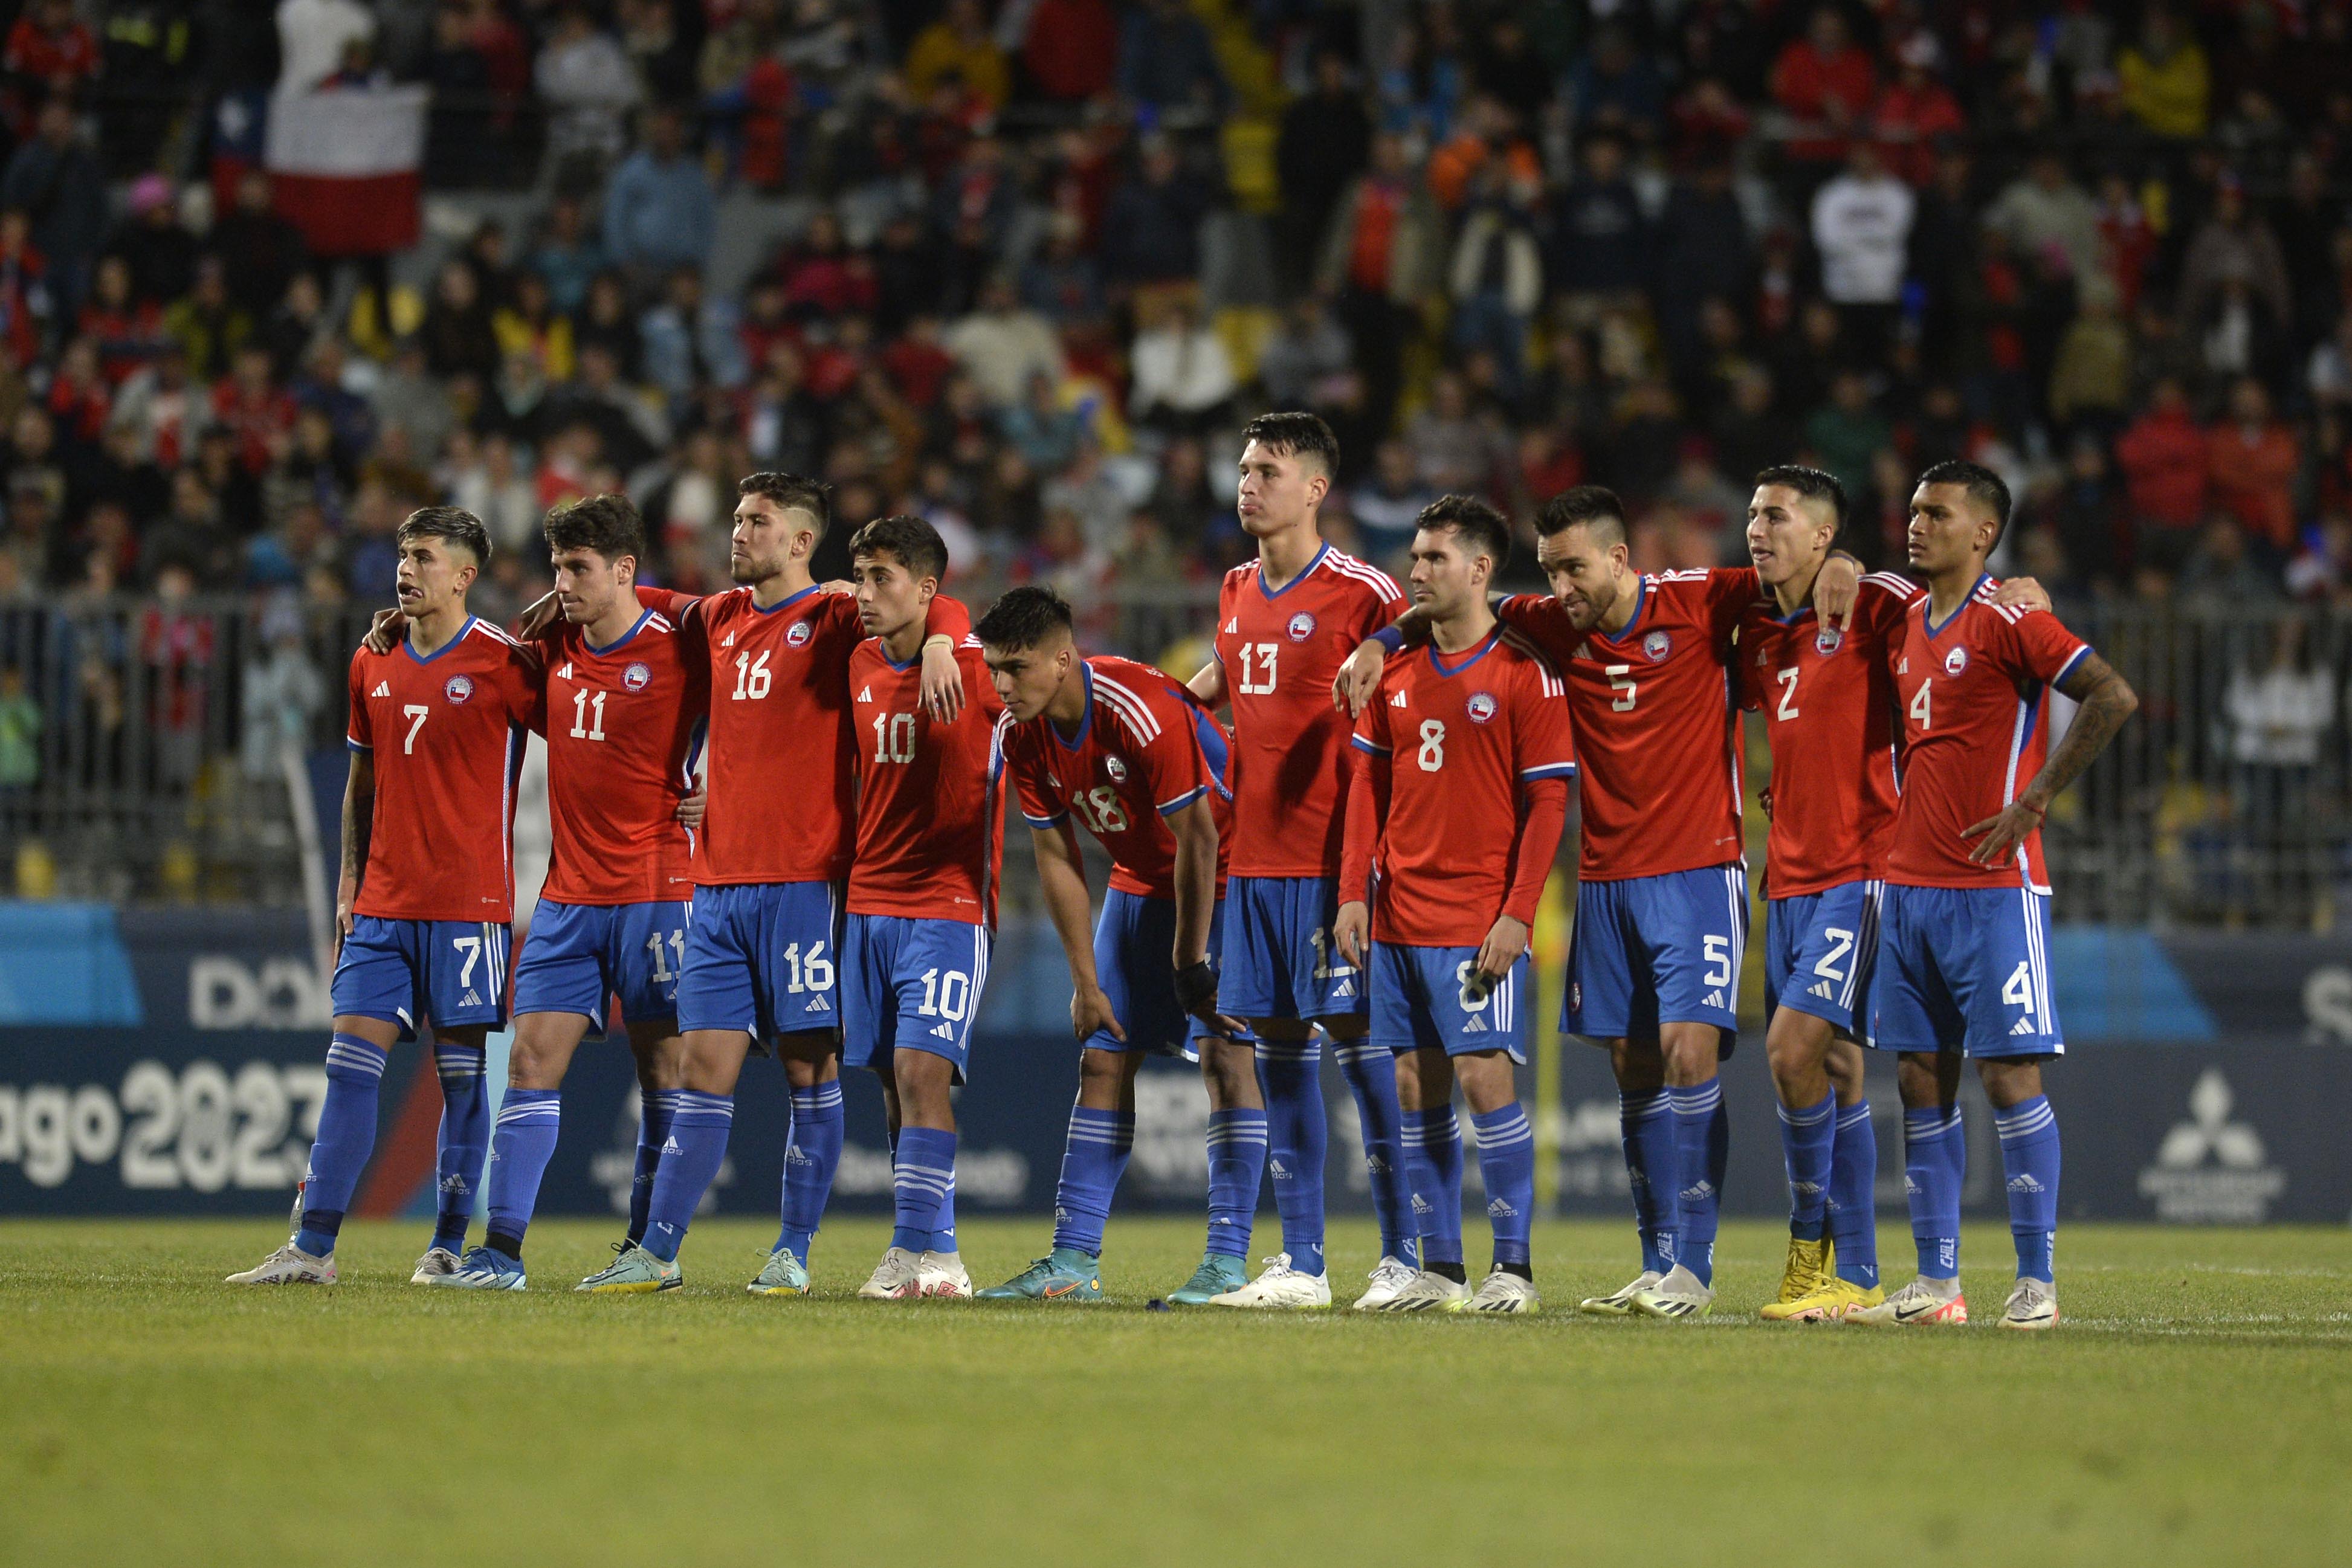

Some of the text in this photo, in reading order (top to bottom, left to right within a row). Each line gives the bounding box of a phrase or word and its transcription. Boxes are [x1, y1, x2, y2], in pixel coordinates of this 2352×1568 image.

[732, 650, 771, 701] 16
[1239, 643, 1279, 695] 13
[1605, 665, 1636, 712] 5
[1777, 666, 1799, 721] 2
[570, 688, 606, 741] 11
[1910, 678, 1931, 730] 4
[404, 705, 428, 755] 7
[873, 712, 915, 764] 10
[1418, 719, 1446, 772] 8
[1072, 786, 1128, 833] 18
[453, 937, 481, 987] 7
[783, 940, 835, 994] 16
[1704, 935, 1730, 987] 5
[1814, 928, 1853, 981] 2
[917, 968, 969, 1022] 10
[1456, 960, 1489, 1013] 8
[2001, 961, 2034, 1015] 4
[662, 1147, 683, 1155] das
[789, 1157, 812, 1166] das
[1272, 1171, 1292, 1179] das
[439, 1184, 470, 1195] adidas
[1412, 1205, 1433, 1214] das
[1488, 1207, 1518, 1217] didas
[1679, 1188, 1715, 1201] adida
